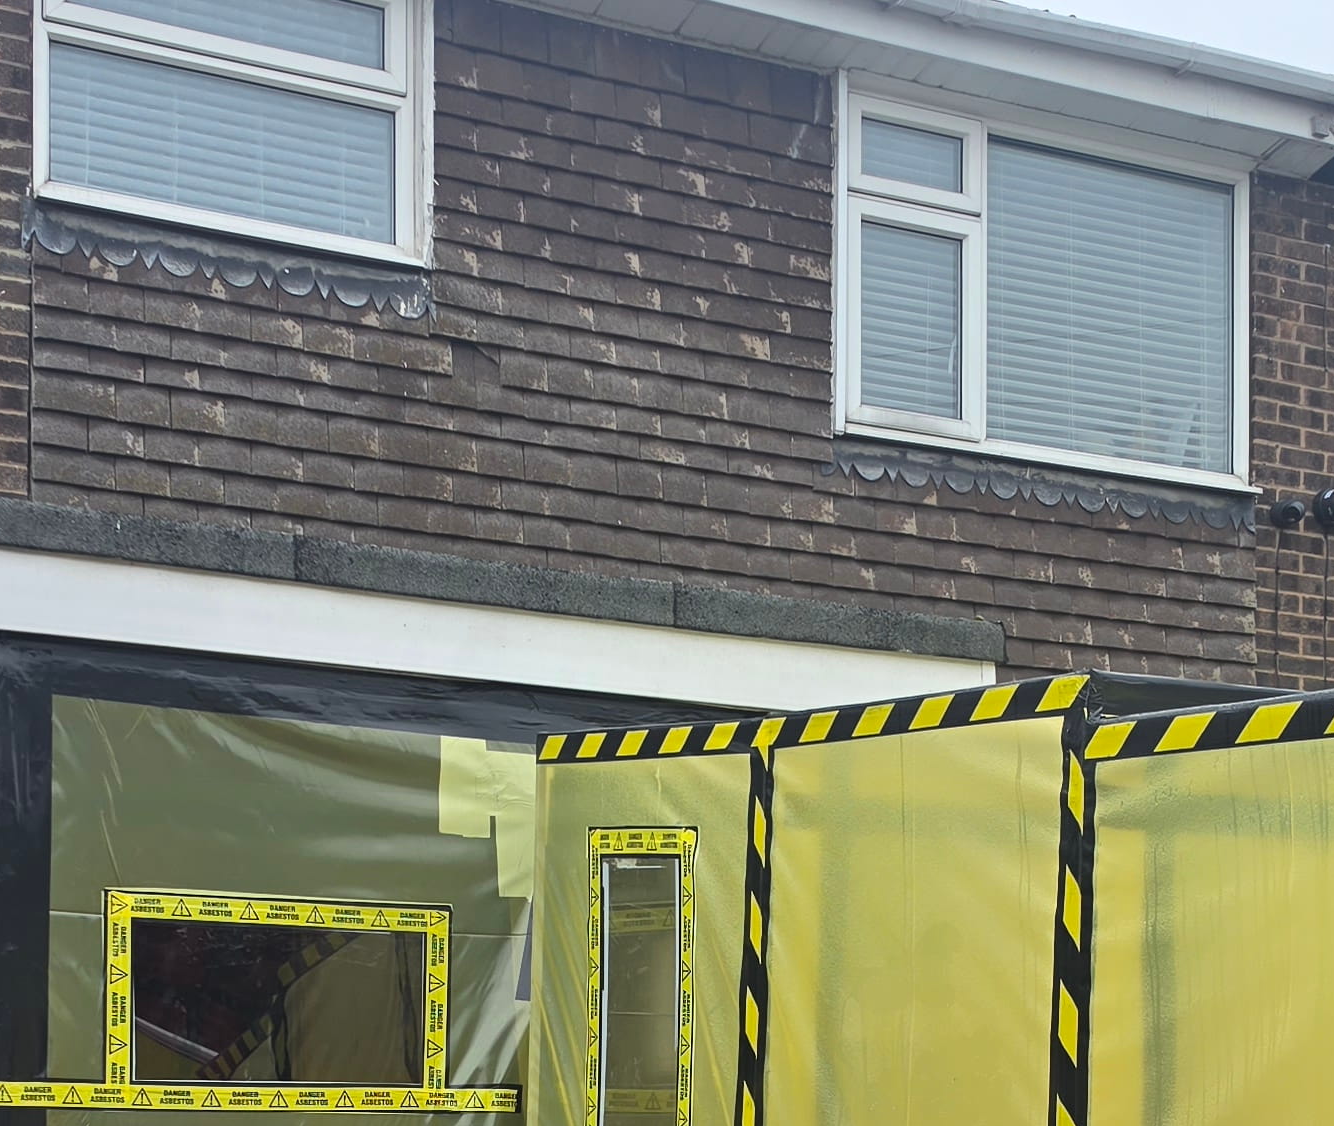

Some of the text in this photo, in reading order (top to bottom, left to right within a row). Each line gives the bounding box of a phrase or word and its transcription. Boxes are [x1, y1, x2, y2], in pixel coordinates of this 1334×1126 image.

[266, 912, 299, 921] ASBESTOS
[332, 916, 364, 924] ASBESTOS
[20, 1093, 55, 1101] ASBESTOS
[90, 1094, 124, 1103] ASBESTOS
[160, 1097, 194, 1105] ASBESTOS
[228, 1098, 262, 1106] ASBESTOS
[296, 1098, 329, 1106] ASBESTOS
[361, 1098, 393, 1106] ASBESTOS
